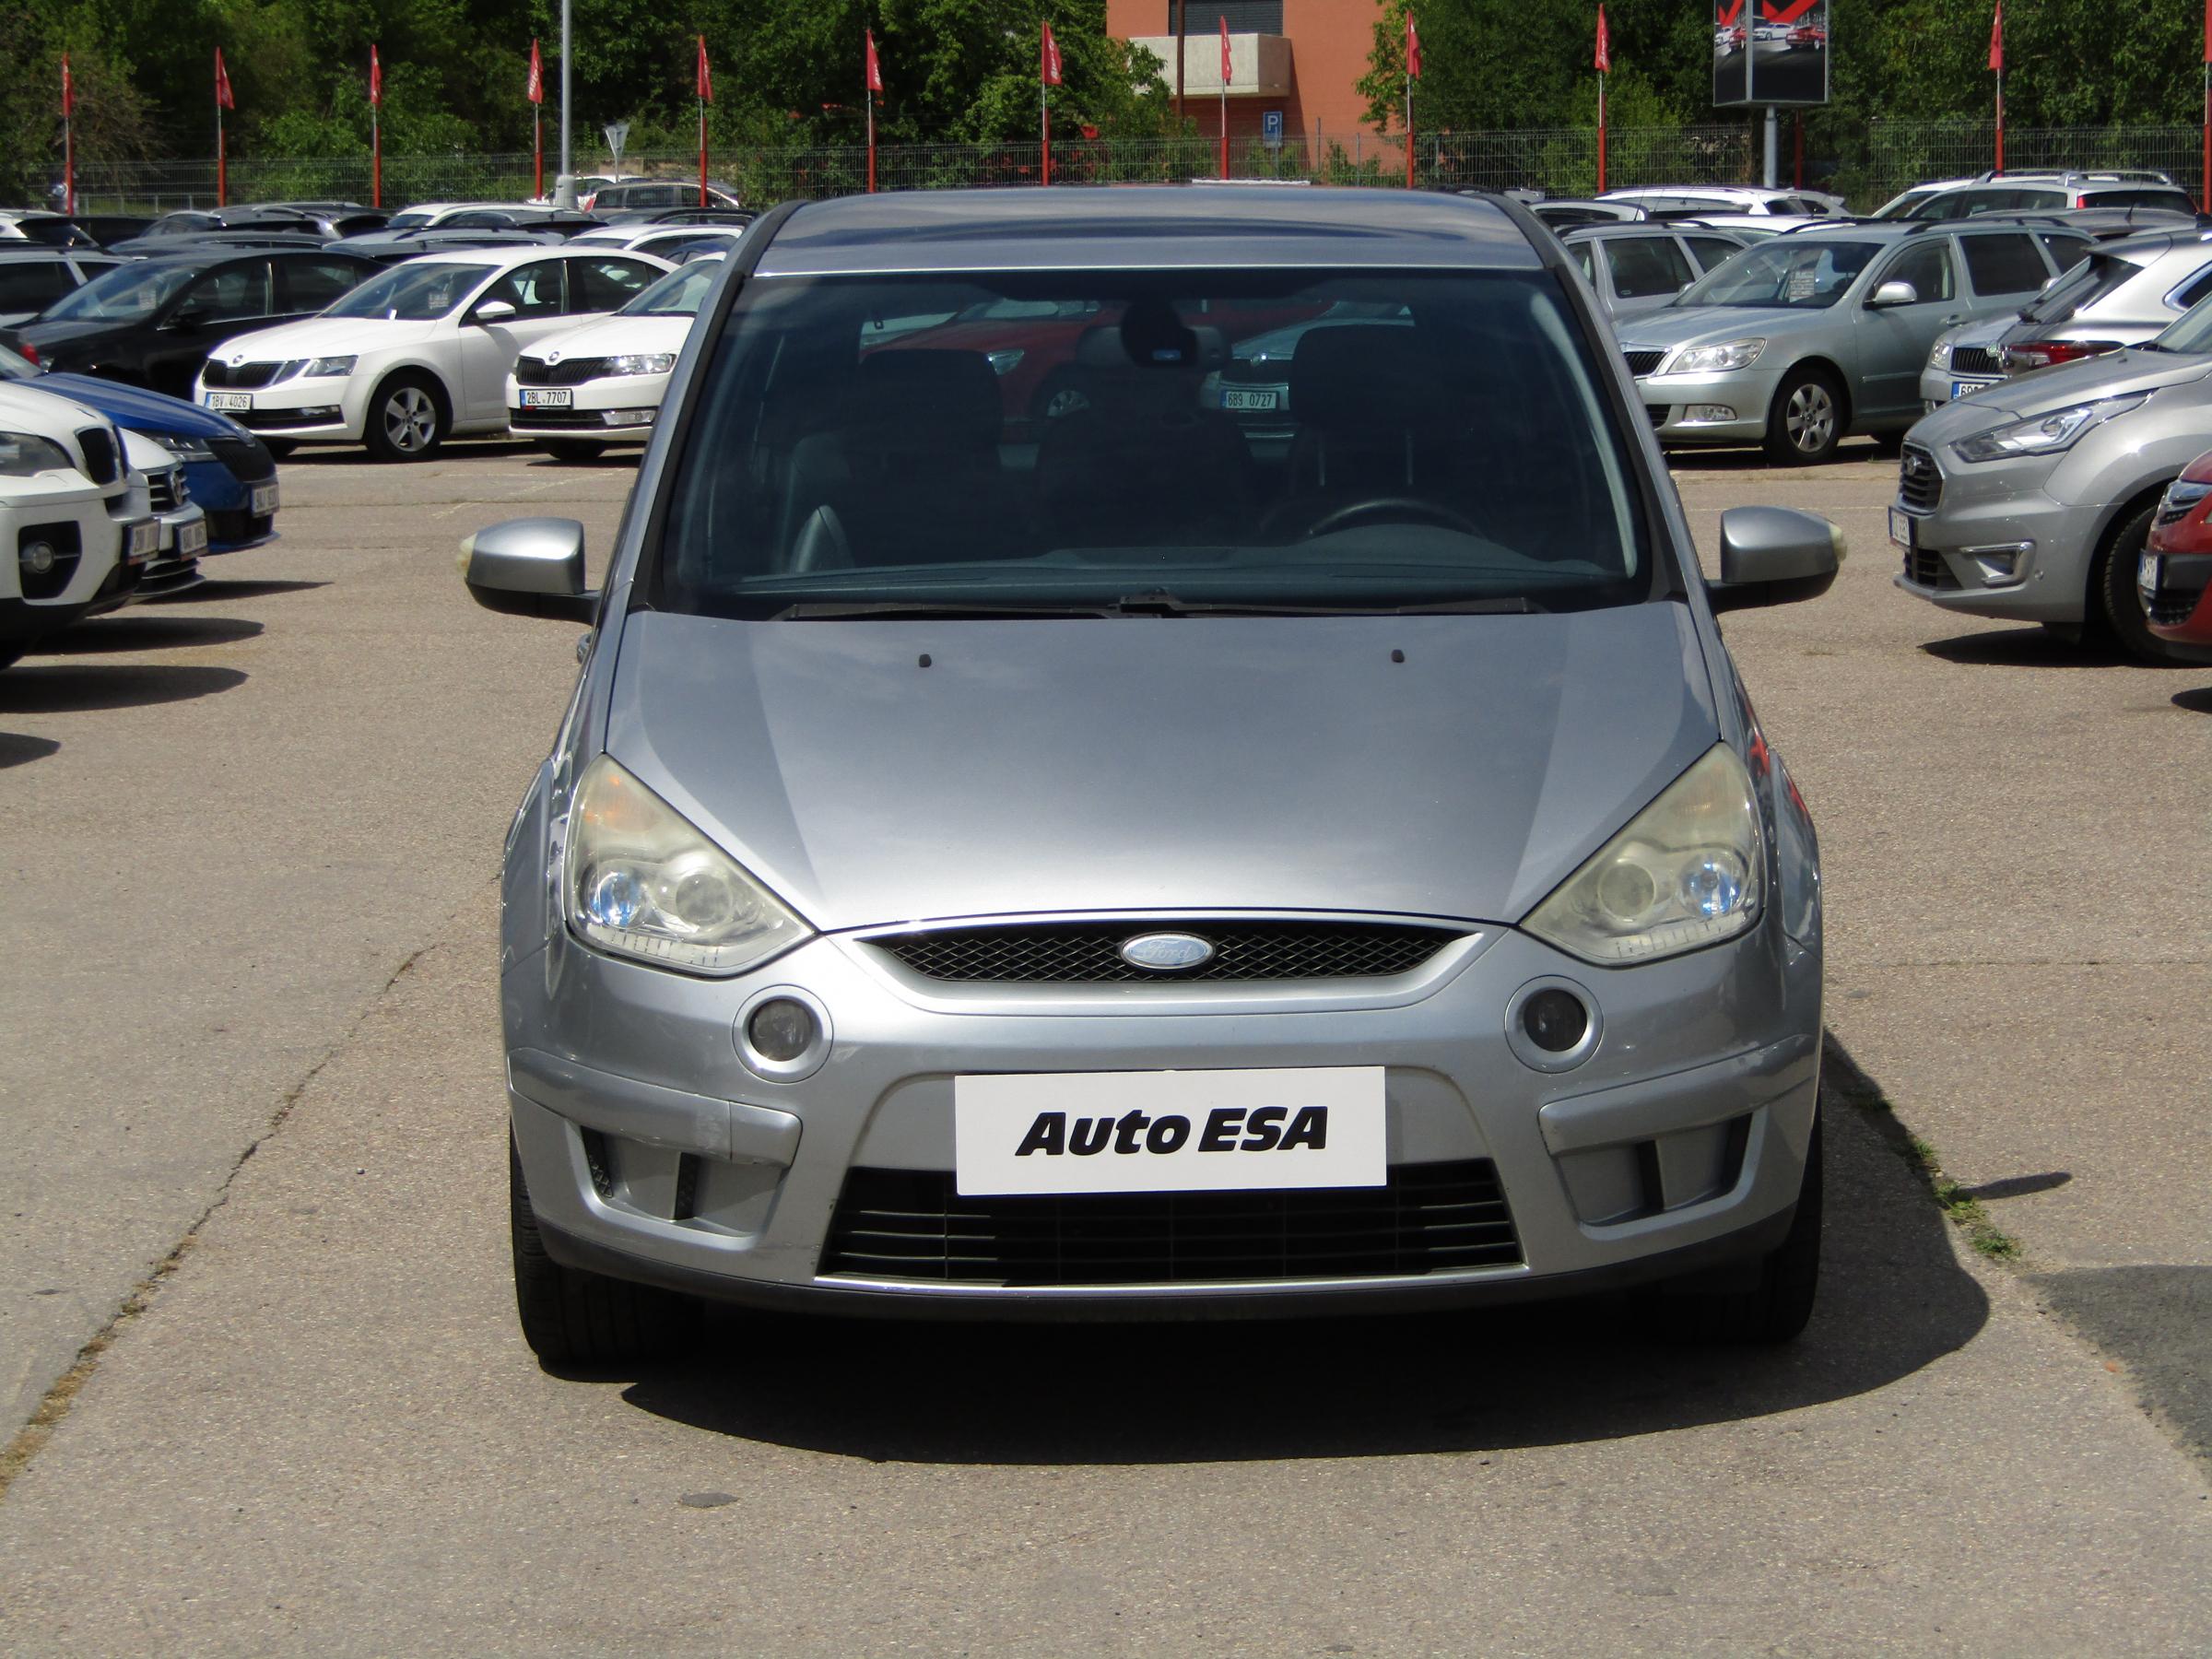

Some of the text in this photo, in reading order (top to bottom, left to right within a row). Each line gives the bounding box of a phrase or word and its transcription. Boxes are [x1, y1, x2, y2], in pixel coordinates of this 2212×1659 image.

[1267, 114, 1278, 132] P
[229, 395, 248, 408] 4026
[526, 391, 567, 405] 2BL 7707
[1249, 394, 1273, 407] 0727
[1144, 939, 1192, 959] Ford
[1015, 1106, 1327, 1156] Auto ESA
